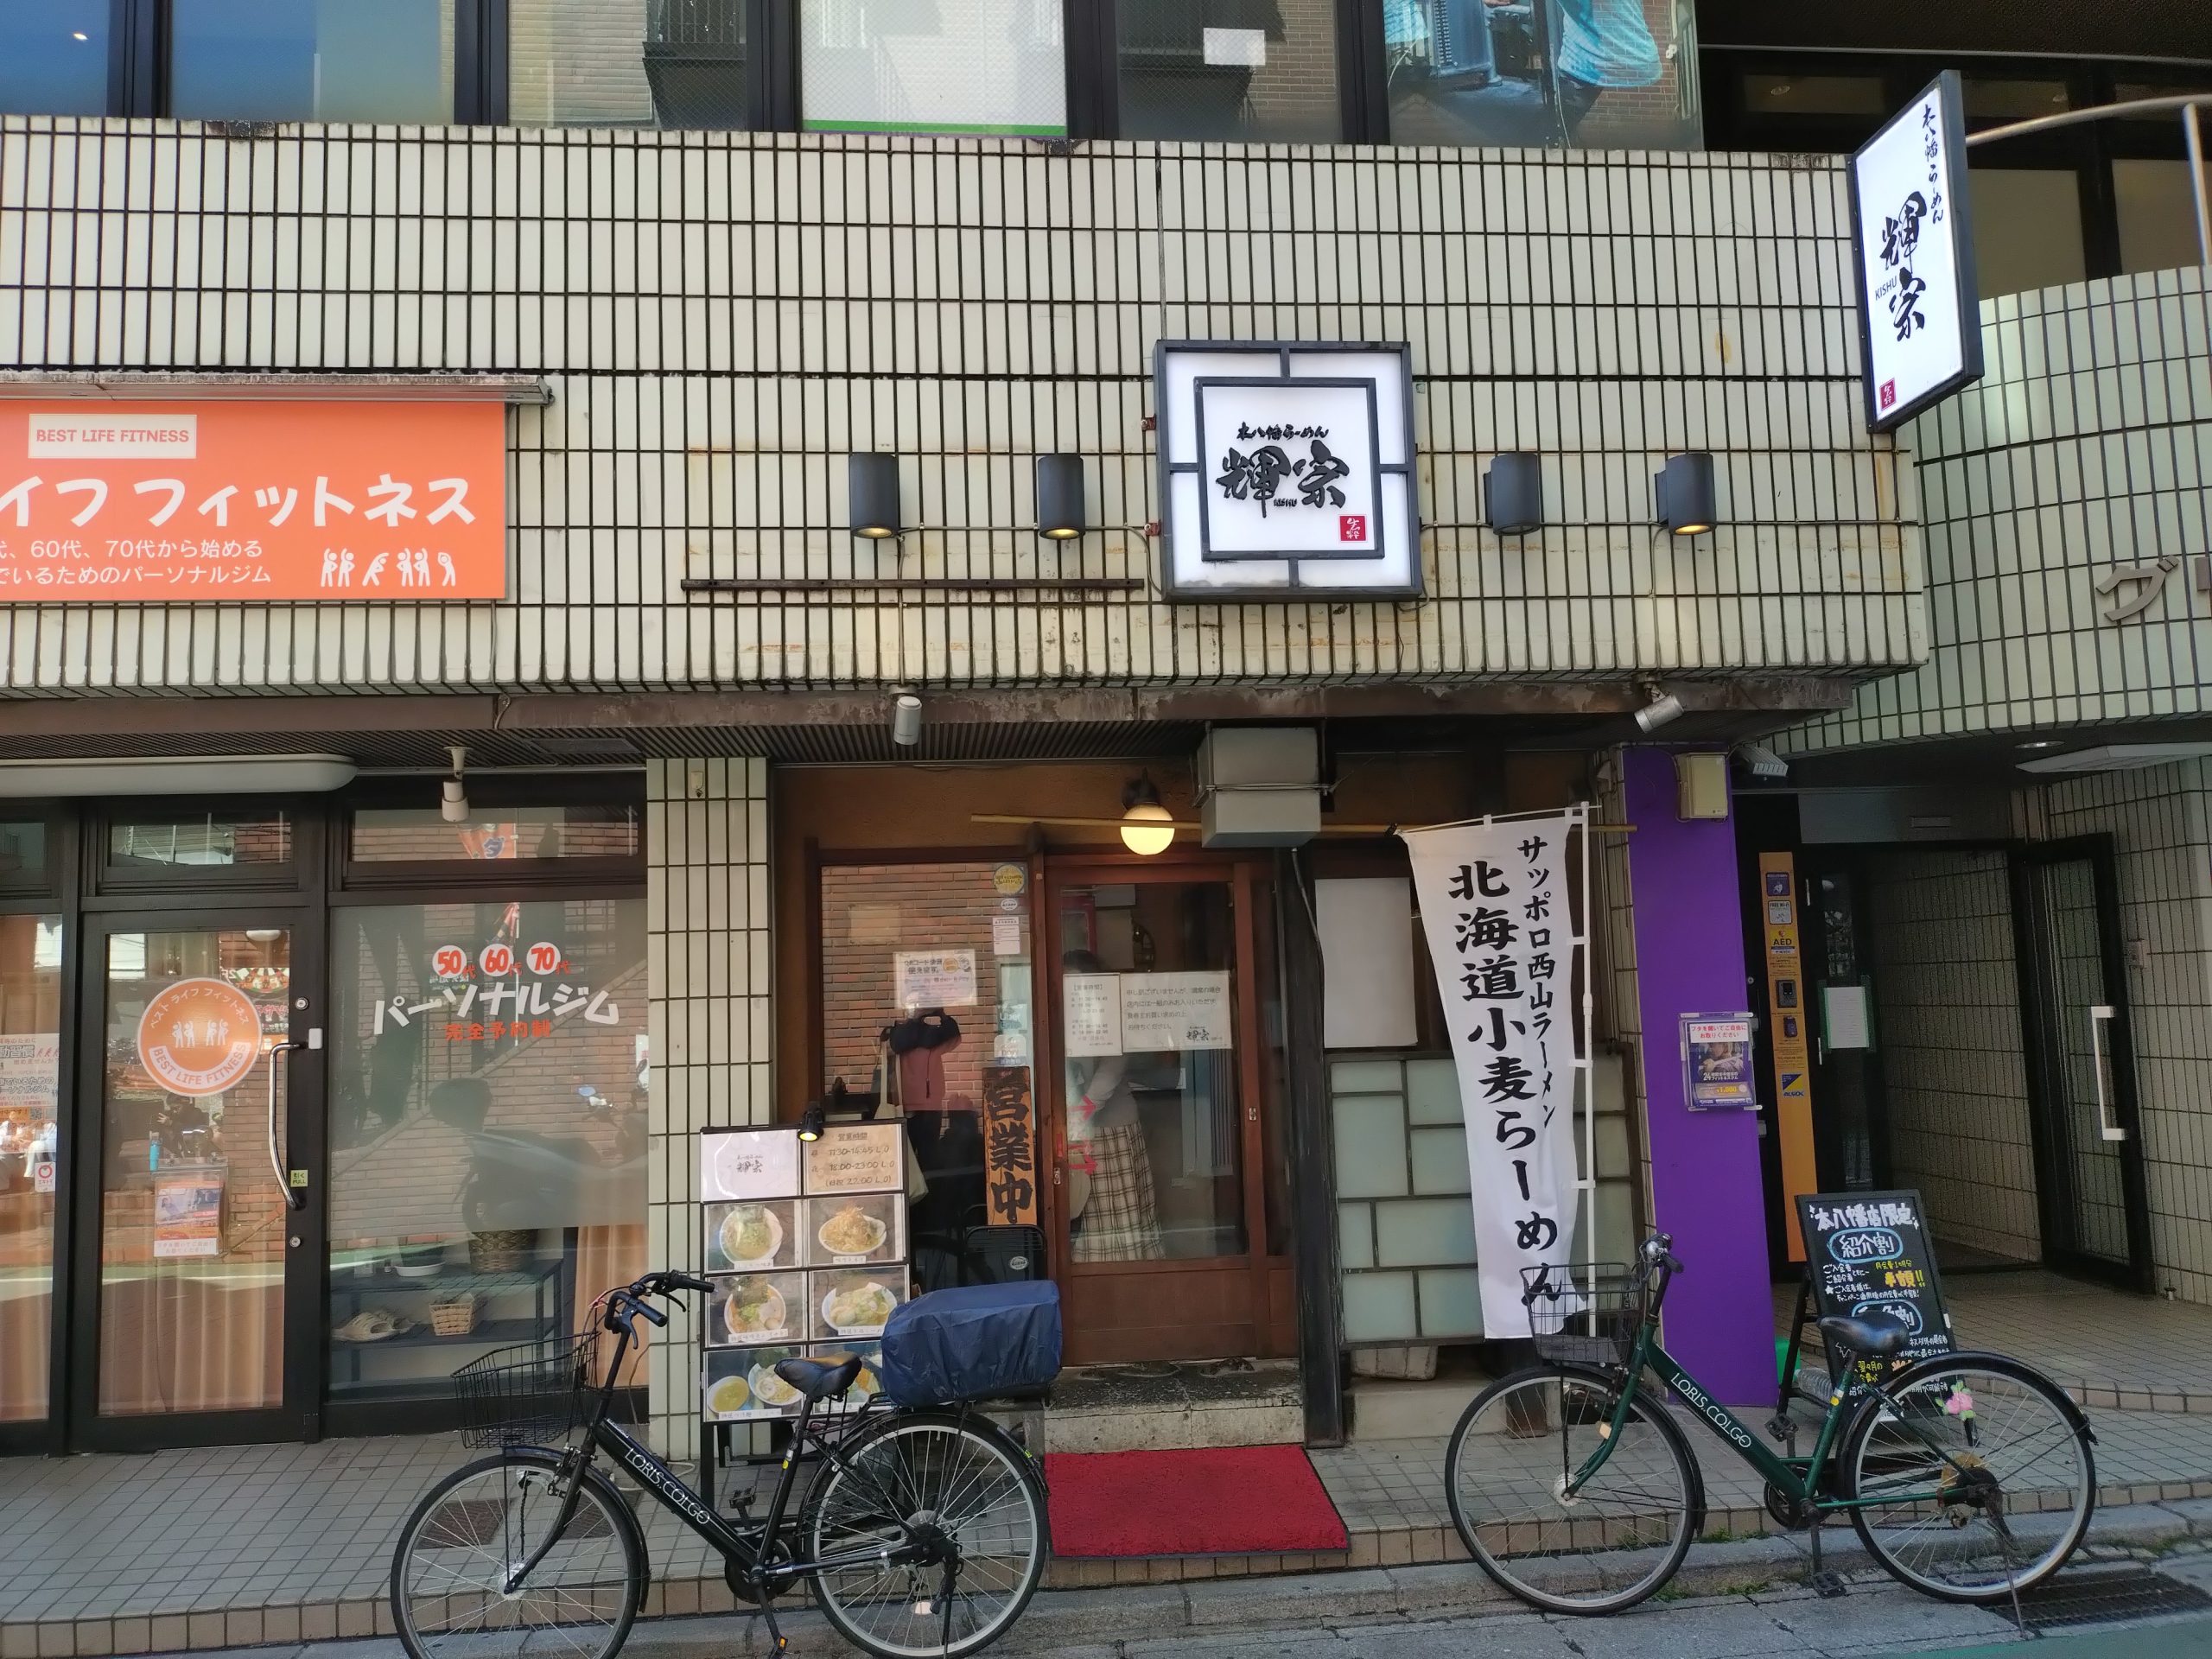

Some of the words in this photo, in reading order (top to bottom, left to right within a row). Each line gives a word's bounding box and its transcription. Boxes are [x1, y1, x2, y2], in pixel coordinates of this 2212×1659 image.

[1875, 275, 1898, 301] KISHU
[36, 429, 77, 442] BEST
[82, 429, 115, 442] LIFE
[120, 429, 189, 442] FITNESS
[1216, 439, 1350, 518] 輝宗
[133, 474, 476, 527] フィットネス
[1274, 498, 1297, 508] KISHU
[149, 1002, 170, 1028] ベスト
[171, 988, 200, 1004] ライフ
[204, 988, 250, 1024] フィットネス
[373, 982, 620, 1035] パーソナルジム
[445, 1020, 551, 1040] 完全予約制
[152, 1048, 176, 1075] BEST
[176, 1071, 202, 1085] LIFE
[207, 1044, 247, 1084] FITNESS
[1447, 860, 1563, 1306] 北海道小麦らーめん
[986, 1082, 1033, 1224] 営業中
[1815, 1202, 1913, 1230] 本八幡店限定
[1839, 1232, 1895, 1258] 紹介割
